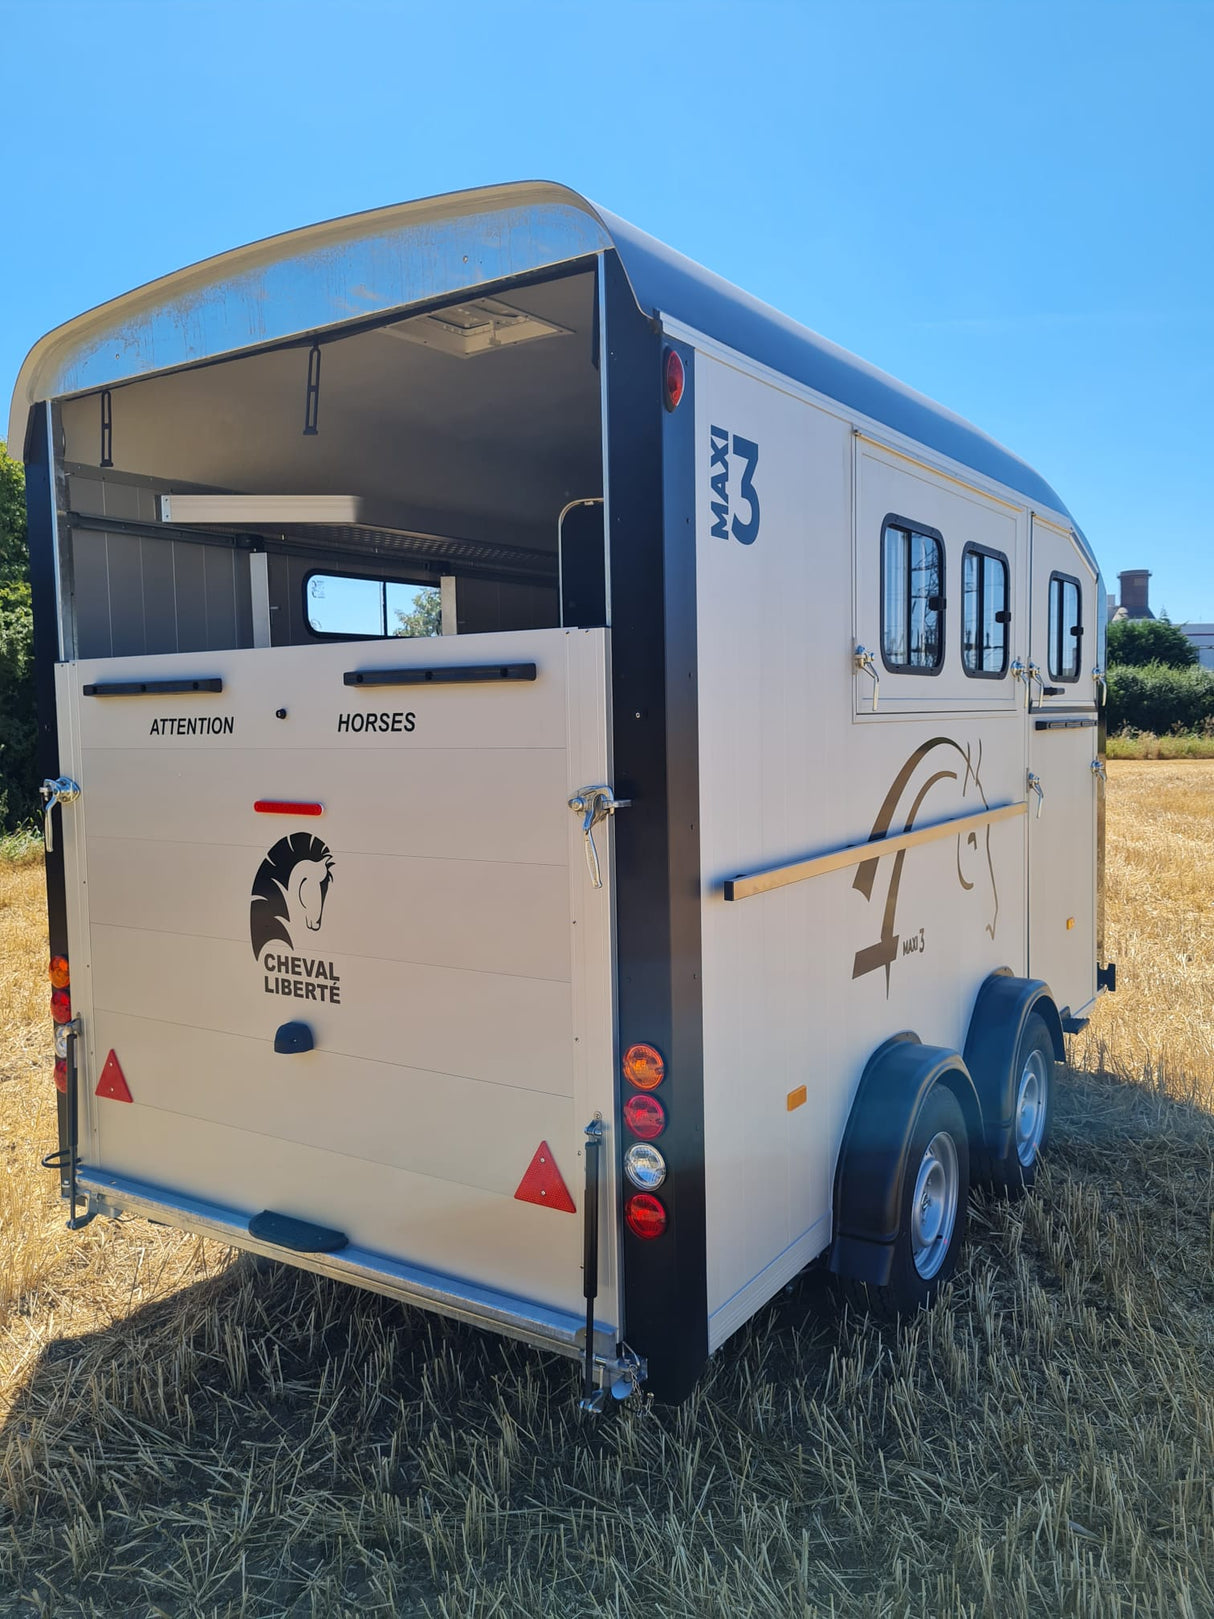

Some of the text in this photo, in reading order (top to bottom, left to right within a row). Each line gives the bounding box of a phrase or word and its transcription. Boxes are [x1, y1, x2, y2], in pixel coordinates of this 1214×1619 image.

[711, 424, 728, 540] MAXI
[732, 434, 760, 545] 3
[150, 713, 416, 735] ATTENTION HORSES
[903, 928, 925, 956] MAXI 3
[264, 953, 340, 982] CHEVAL
[264, 975, 341, 1004] LIBERTÉ
